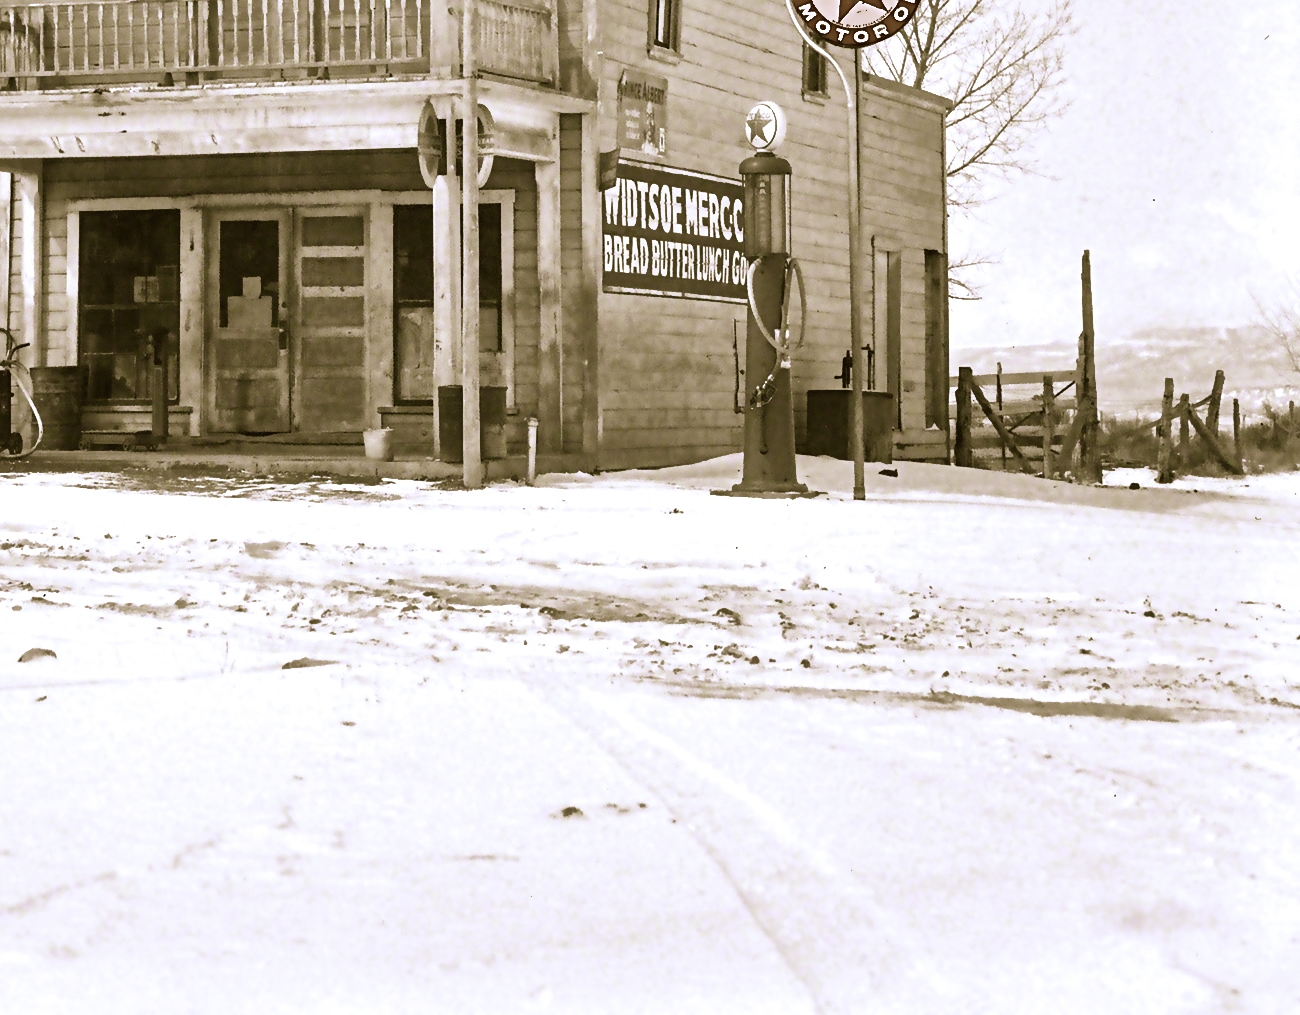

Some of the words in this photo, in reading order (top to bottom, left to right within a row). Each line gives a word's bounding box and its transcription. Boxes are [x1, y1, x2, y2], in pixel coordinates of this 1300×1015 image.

[799, 3, 889, 43] MOTOR
[605, 178, 682, 234] WIDTSOE
[604, 234, 649, 275] BREAD
[651, 240, 695, 280] BUTTER
[697, 245, 730, 284] LUNCH
